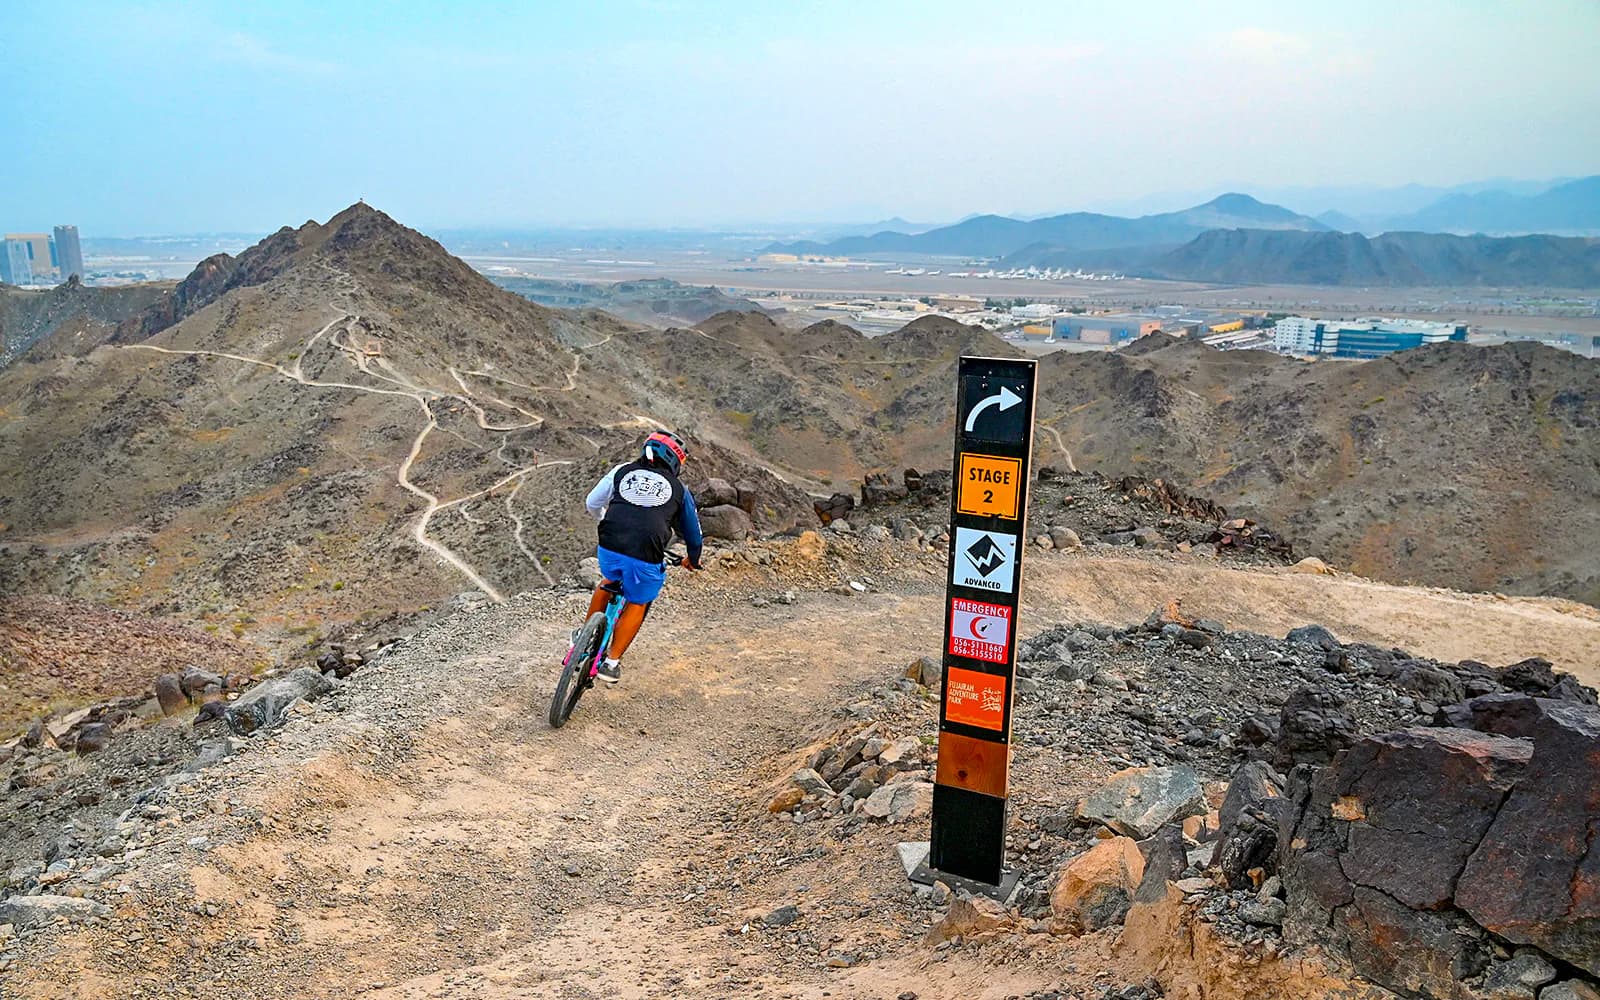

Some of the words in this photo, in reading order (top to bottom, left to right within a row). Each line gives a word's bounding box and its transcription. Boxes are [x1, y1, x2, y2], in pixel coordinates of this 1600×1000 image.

[969, 467, 1010, 485] STAGE
[983, 490, 994, 503] 2
[964, 577, 1001, 590] ADVANCED
[953, 600, 1009, 618] EMERGENCY
[954, 638, 1003, 654] 056-5111660
[948, 695, 962, 705] PARK
[949, 688, 980, 701] ADVENTURE
